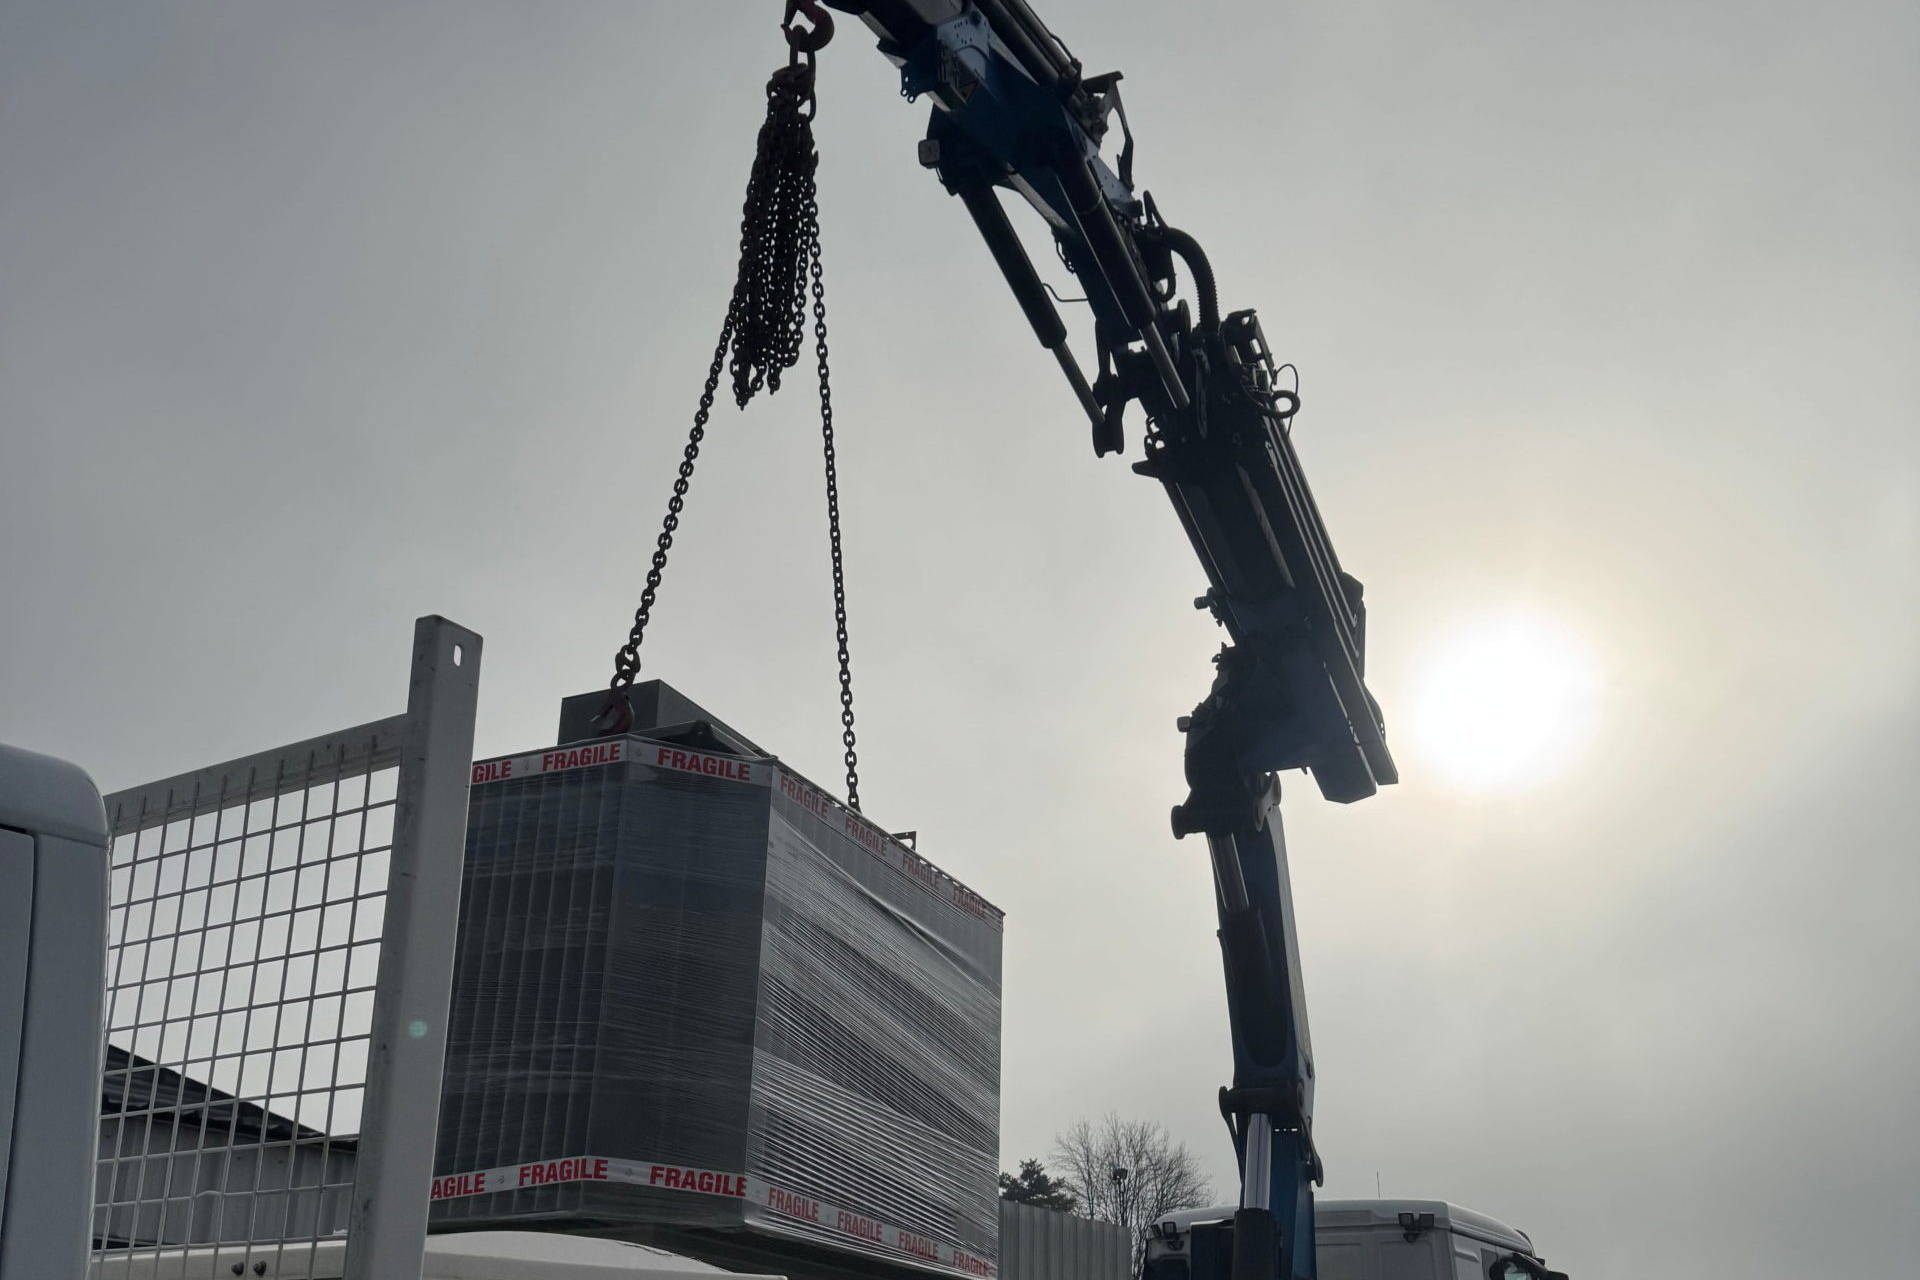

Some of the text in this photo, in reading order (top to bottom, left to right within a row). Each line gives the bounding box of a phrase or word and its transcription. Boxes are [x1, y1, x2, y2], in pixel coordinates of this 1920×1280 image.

[542, 743, 621, 771] FRAGILE
[657, 748, 751, 781] FRAGILE
[780, 774, 828, 819] FRAGILE
[845, 816, 887, 857] FRAGILE
[902, 853, 939, 889] FRAGILE
[431, 1158, 609, 1199] AGILE FRAGILE
[650, 1165, 746, 1197] FRAGILE
[769, 1187, 819, 1222] FRAGILE
[837, 1211, 882, 1242] FRAGILE
[899, 1231, 939, 1260] FRAGILE
